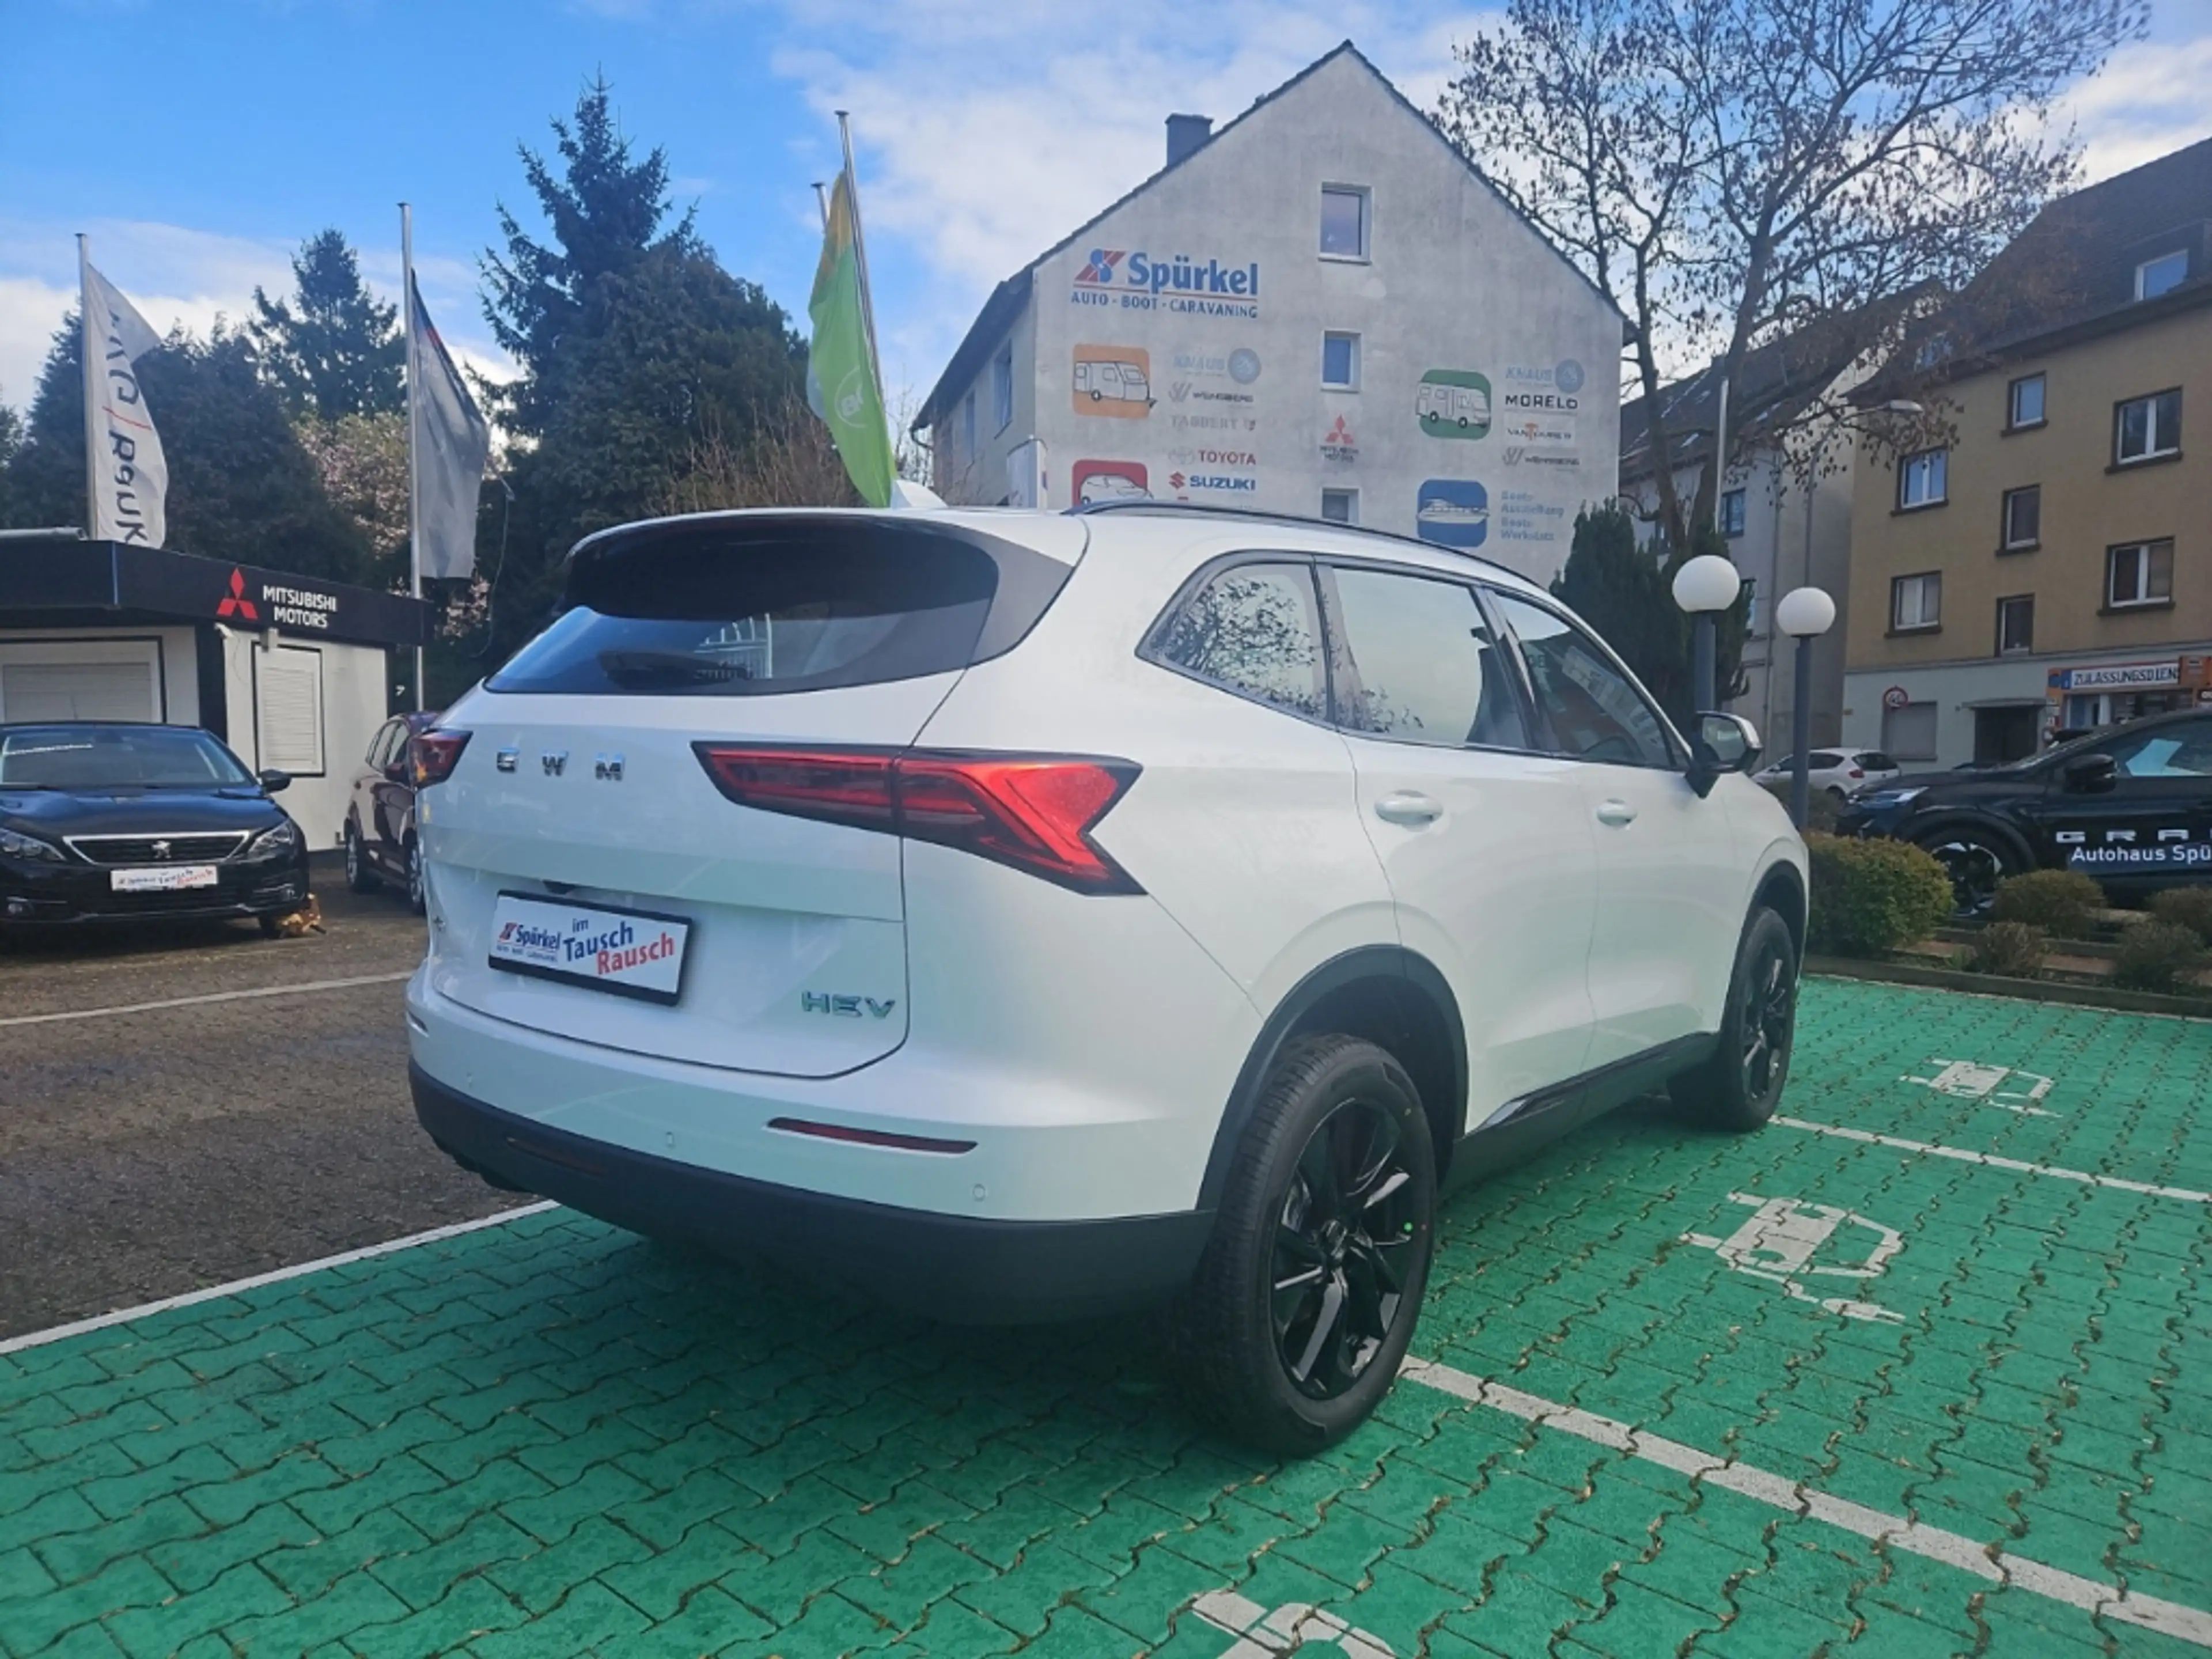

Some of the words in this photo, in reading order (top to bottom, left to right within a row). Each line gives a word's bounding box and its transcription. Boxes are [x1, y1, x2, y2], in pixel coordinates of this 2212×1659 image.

[1128, 252, 1257, 296] Spürkel
[1071, 291, 1109, 306] AUTO
[1121, 296, 1158, 310] BOOT
[1170, 298, 1257, 318] CARAVANING
[1505, 394, 1578, 410] MORELO
[1199, 449, 1256, 465] TOYOTA
[1190, 475, 1256, 490] SUZUKI
[263, 585, 336, 612] MITSUBISHI
[274, 605, 328, 628] MOTORS
[2071, 846, 2166, 862] Autohaus
[516, 923, 561, 949] Spürkel
[572, 918, 589, 933] im
[562, 921, 633, 961] Tausch
[597, 931, 675, 975] Rausch
[801, 991, 896, 1019] HEV
